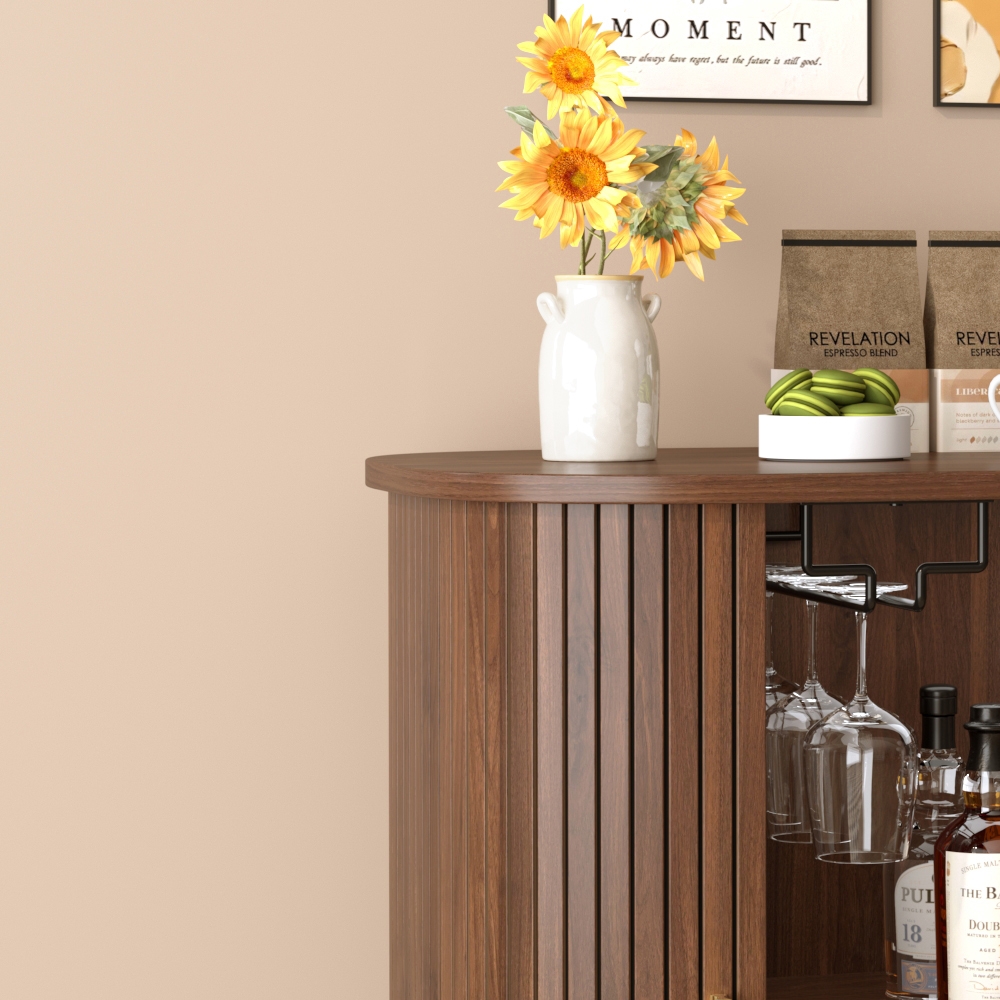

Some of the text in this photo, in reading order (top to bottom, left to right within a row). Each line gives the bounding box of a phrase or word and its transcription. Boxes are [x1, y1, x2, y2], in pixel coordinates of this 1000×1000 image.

[611, 18, 812, 42] MOMENT
[638, 53, 666, 65] always
[668, 53, 687, 63] have
[716, 55, 730, 64] but
[732, 55, 745, 64] the
[745, 55, 771, 67] future
[773, 57, 781, 65] is
[783, 56, 801, 66] still
[799, 56, 823, 68] good.
[809, 331, 911, 346] REVELATION
[823, 348, 898, 358] ESPRESSO BLEND
[960, 887, 983, 899] THE
[902, 923, 922, 943] 18
